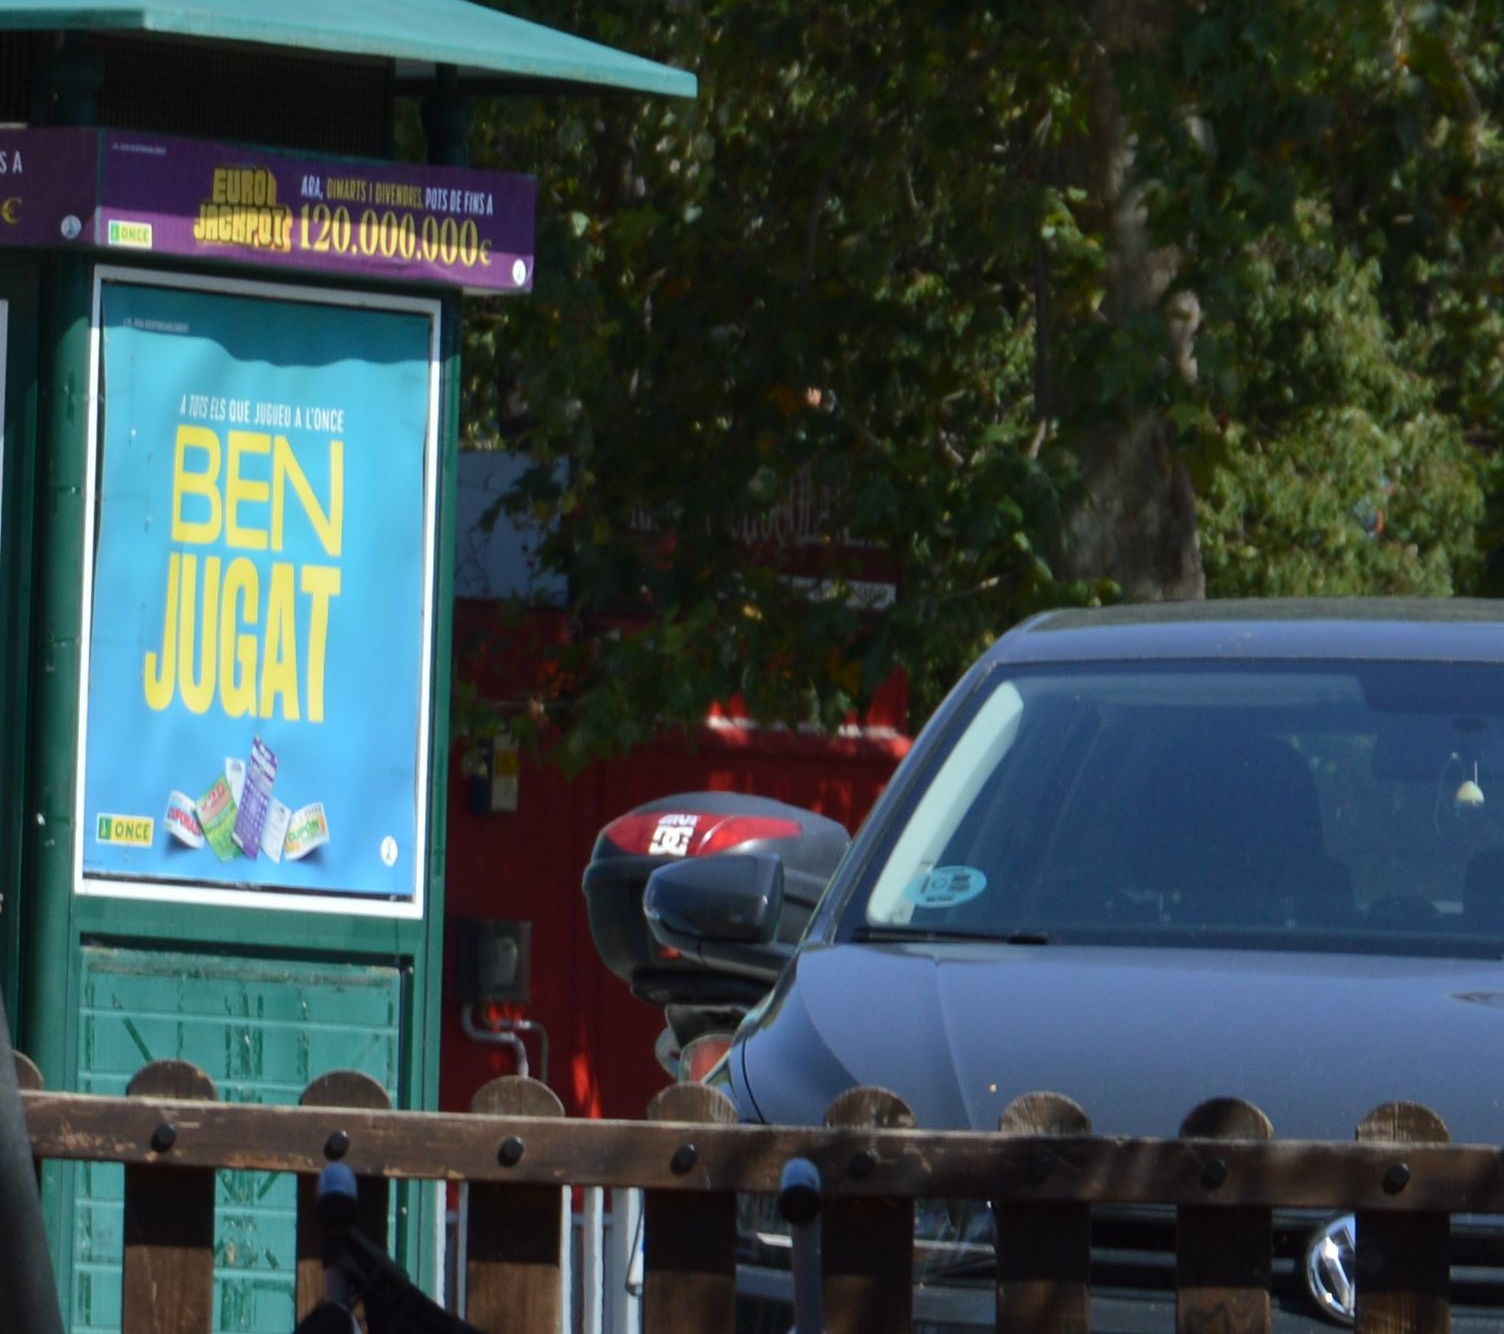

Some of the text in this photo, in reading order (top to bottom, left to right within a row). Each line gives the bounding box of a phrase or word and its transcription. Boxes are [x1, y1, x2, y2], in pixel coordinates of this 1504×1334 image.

[12, 150, 24, 173] A
[212, 167, 272, 205] EURO
[300, 175, 324, 200] ARA,
[326, 176, 367, 202] DIMARTS
[425, 186, 448, 211] POTS
[449, 190, 462, 212] DE
[463, 190, 485, 214] FINS
[486, 193, 494, 216] A
[120, 226, 151, 243] ONCE
[194, 201, 289, 249] JACKPOT
[299, 203, 492, 266] 120.000.000€
[180, 394, 345, 434] A TOTS ELS QUE JUGUEU A L'ONCE
[170, 424, 345, 557] BEN
[143, 552, 342, 724] JUGAT
[114, 822, 150, 844] ONCE
